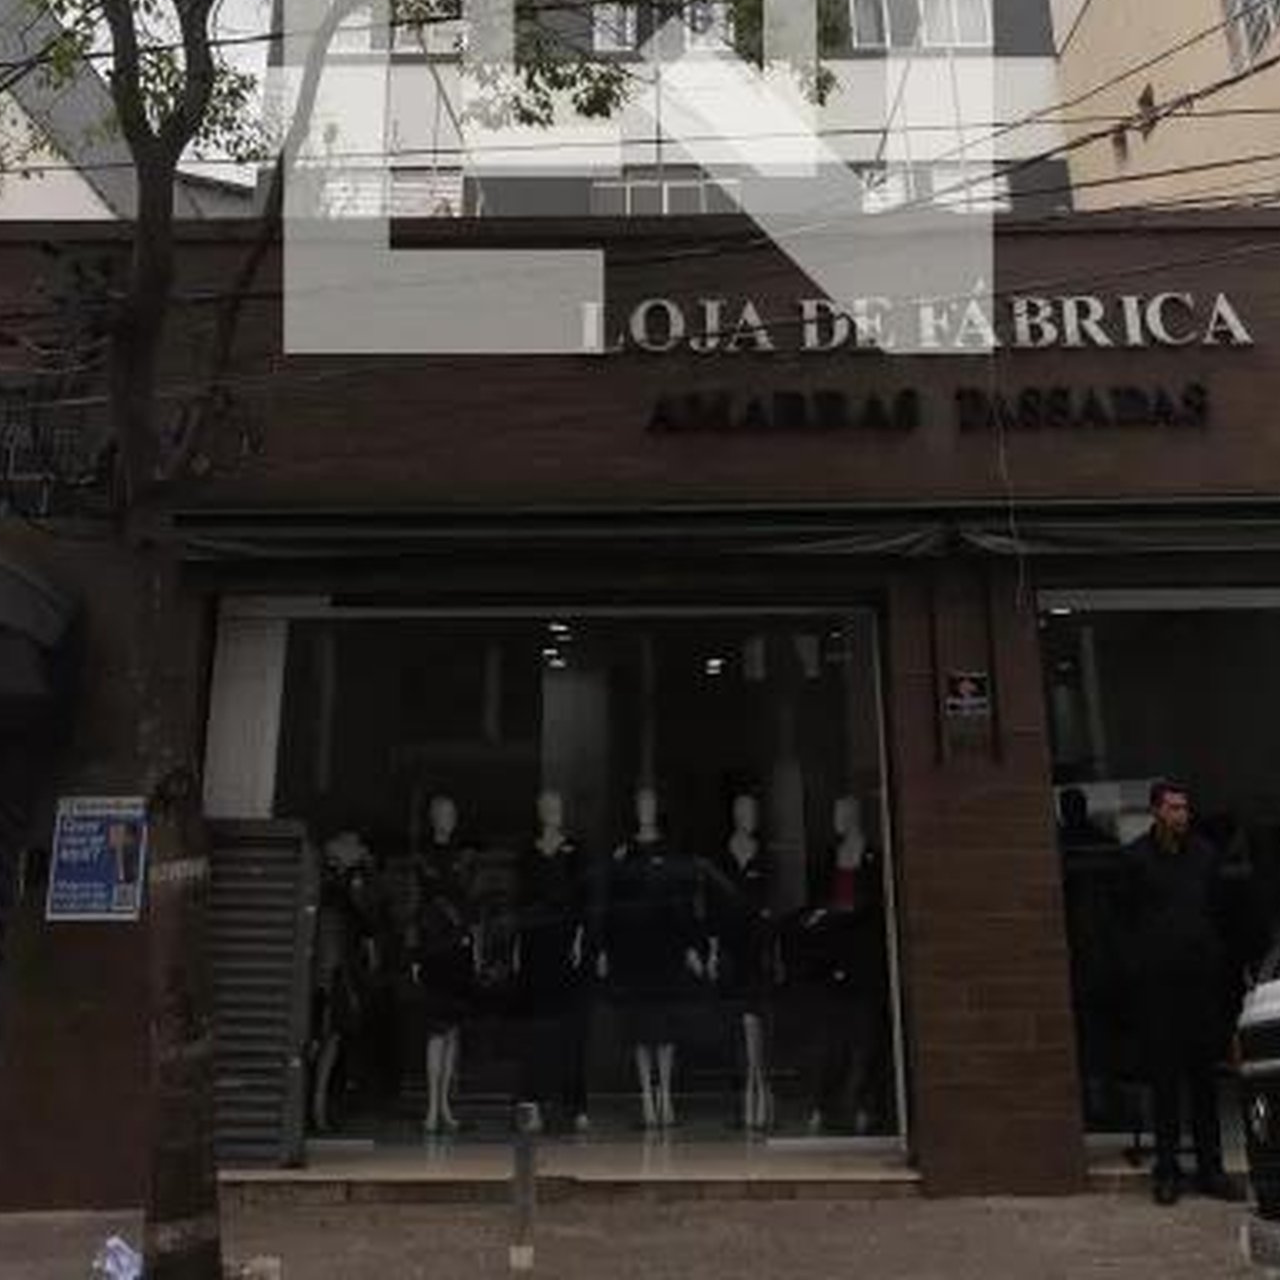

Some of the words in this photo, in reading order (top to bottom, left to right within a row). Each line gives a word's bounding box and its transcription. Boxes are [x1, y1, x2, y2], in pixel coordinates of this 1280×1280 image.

[580, 297, 775, 353] LOJA
[800, 297, 894, 351] DE
[919, 277, 1253, 350] FÁBRICA
